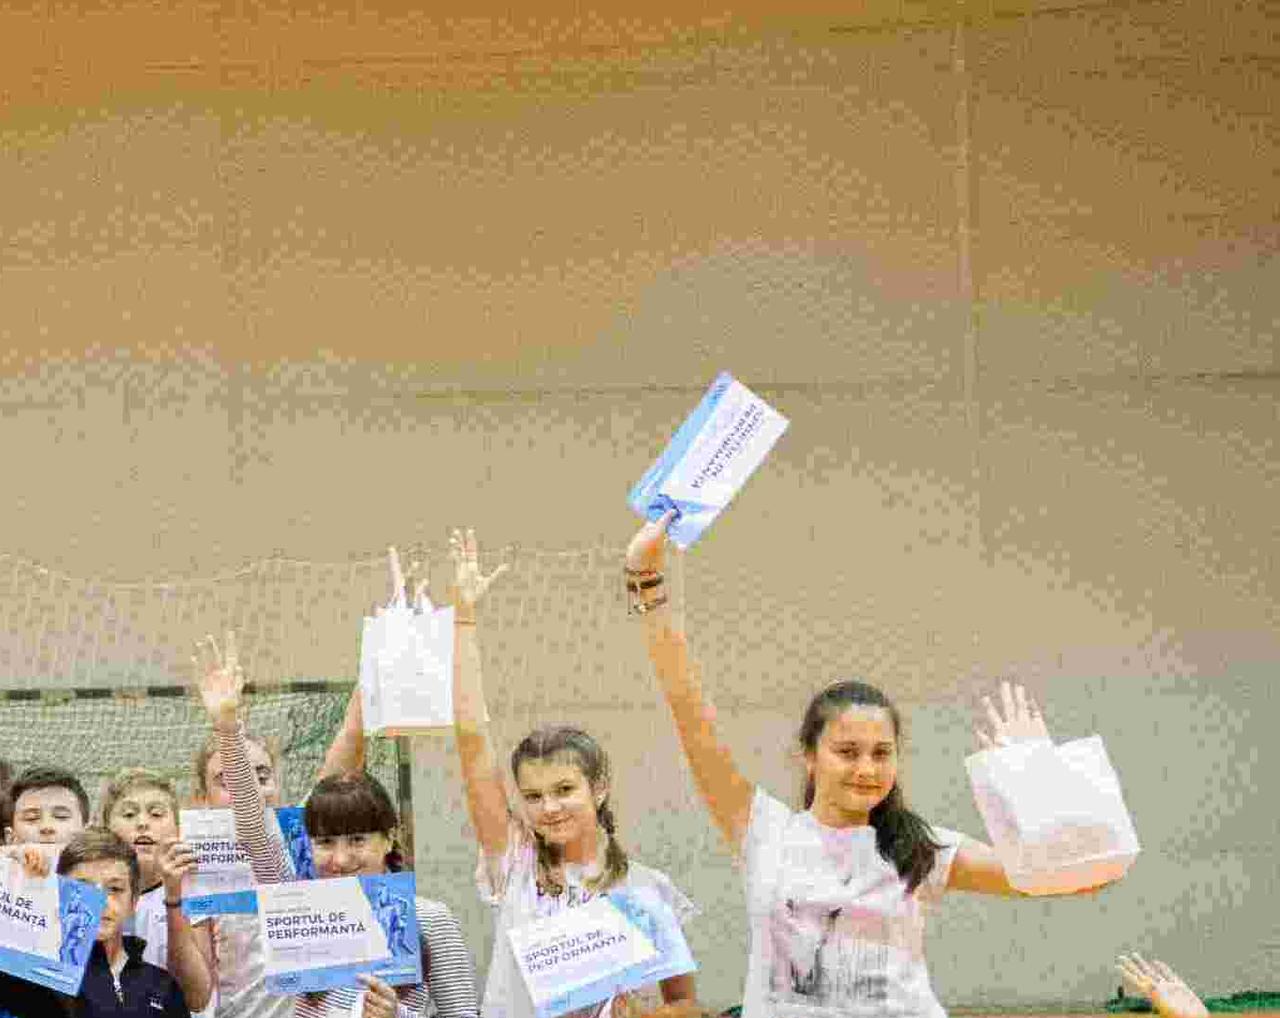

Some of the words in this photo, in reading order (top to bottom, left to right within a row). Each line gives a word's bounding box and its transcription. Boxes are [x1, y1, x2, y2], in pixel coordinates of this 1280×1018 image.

[15, 897, 33, 911] DE
[266, 914, 323, 928] SPORTUL
[328, 912, 346, 923] DE
